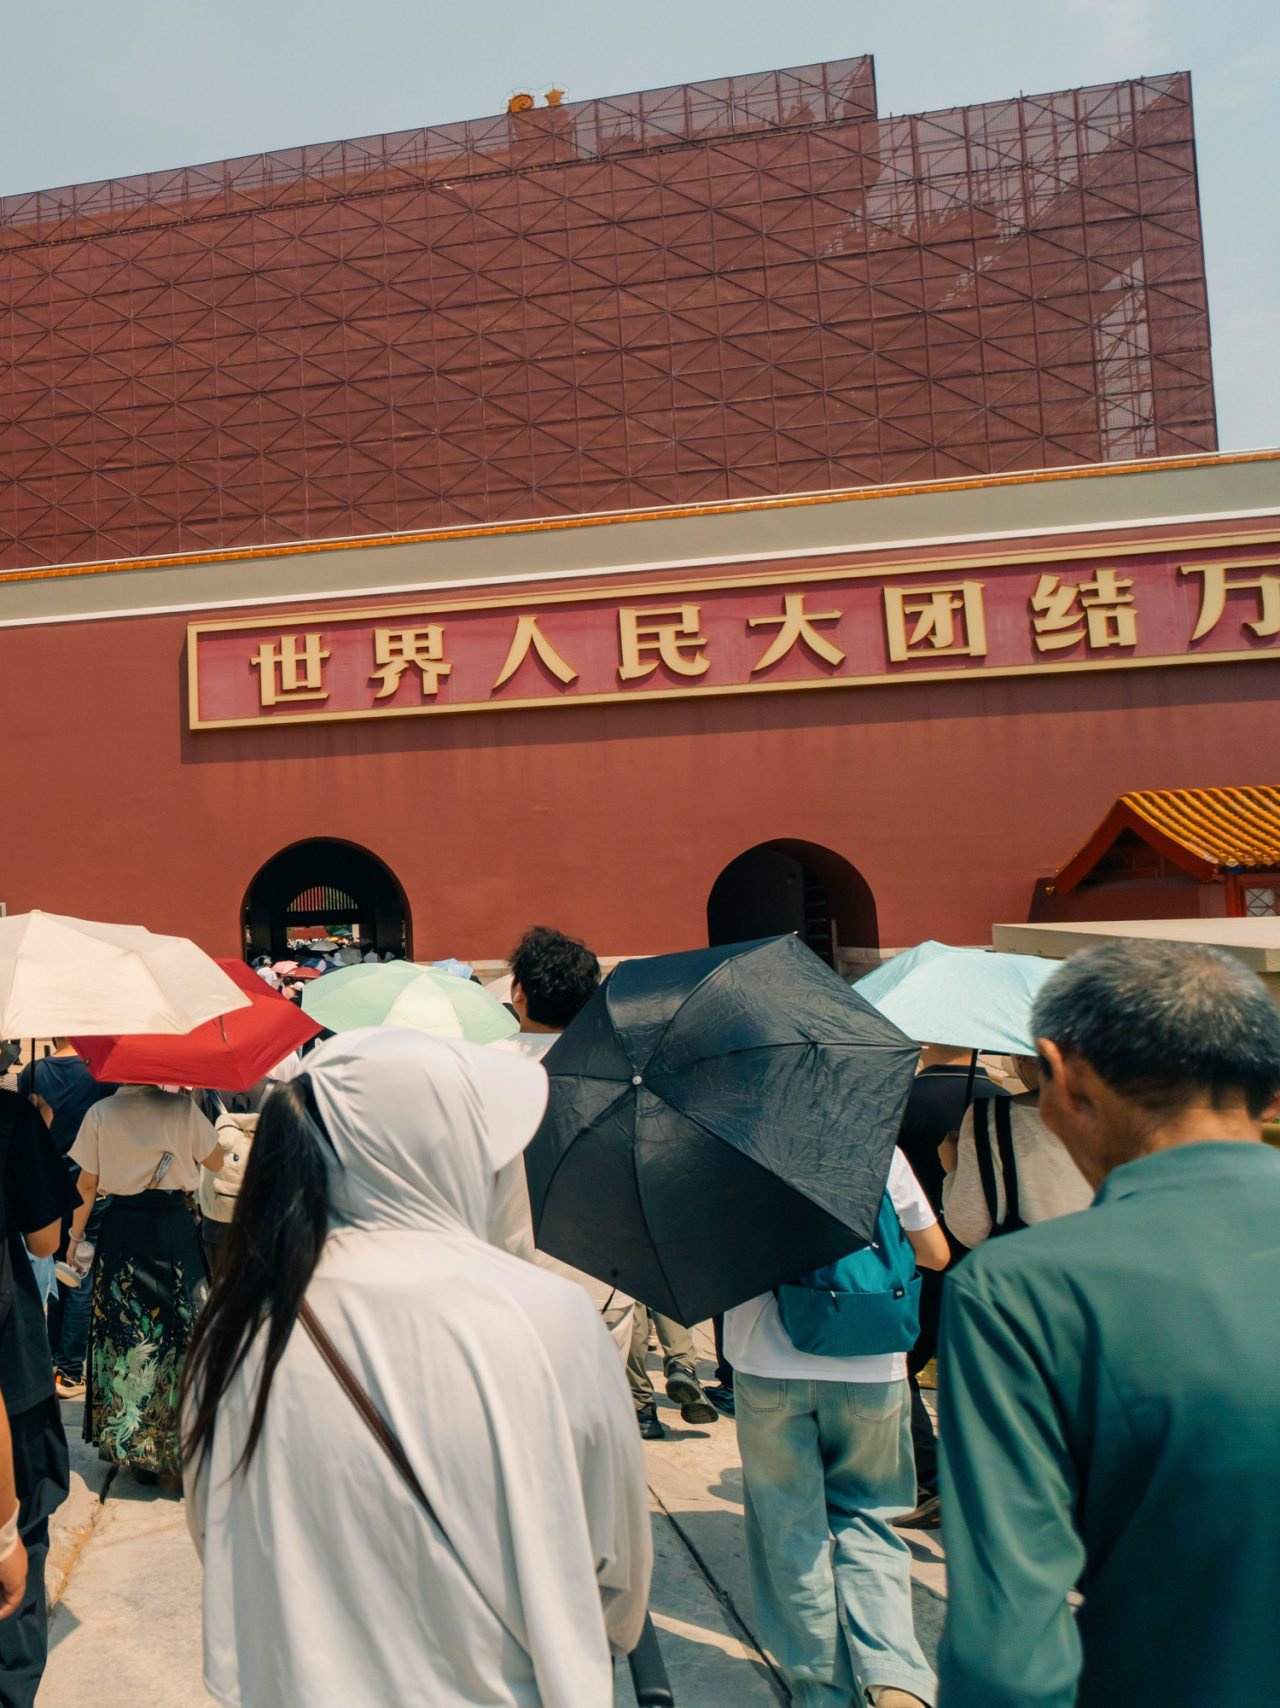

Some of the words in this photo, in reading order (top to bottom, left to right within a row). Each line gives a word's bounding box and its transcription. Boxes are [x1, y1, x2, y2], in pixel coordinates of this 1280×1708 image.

[251, 559, 1280, 706] 世界人民大团结万
